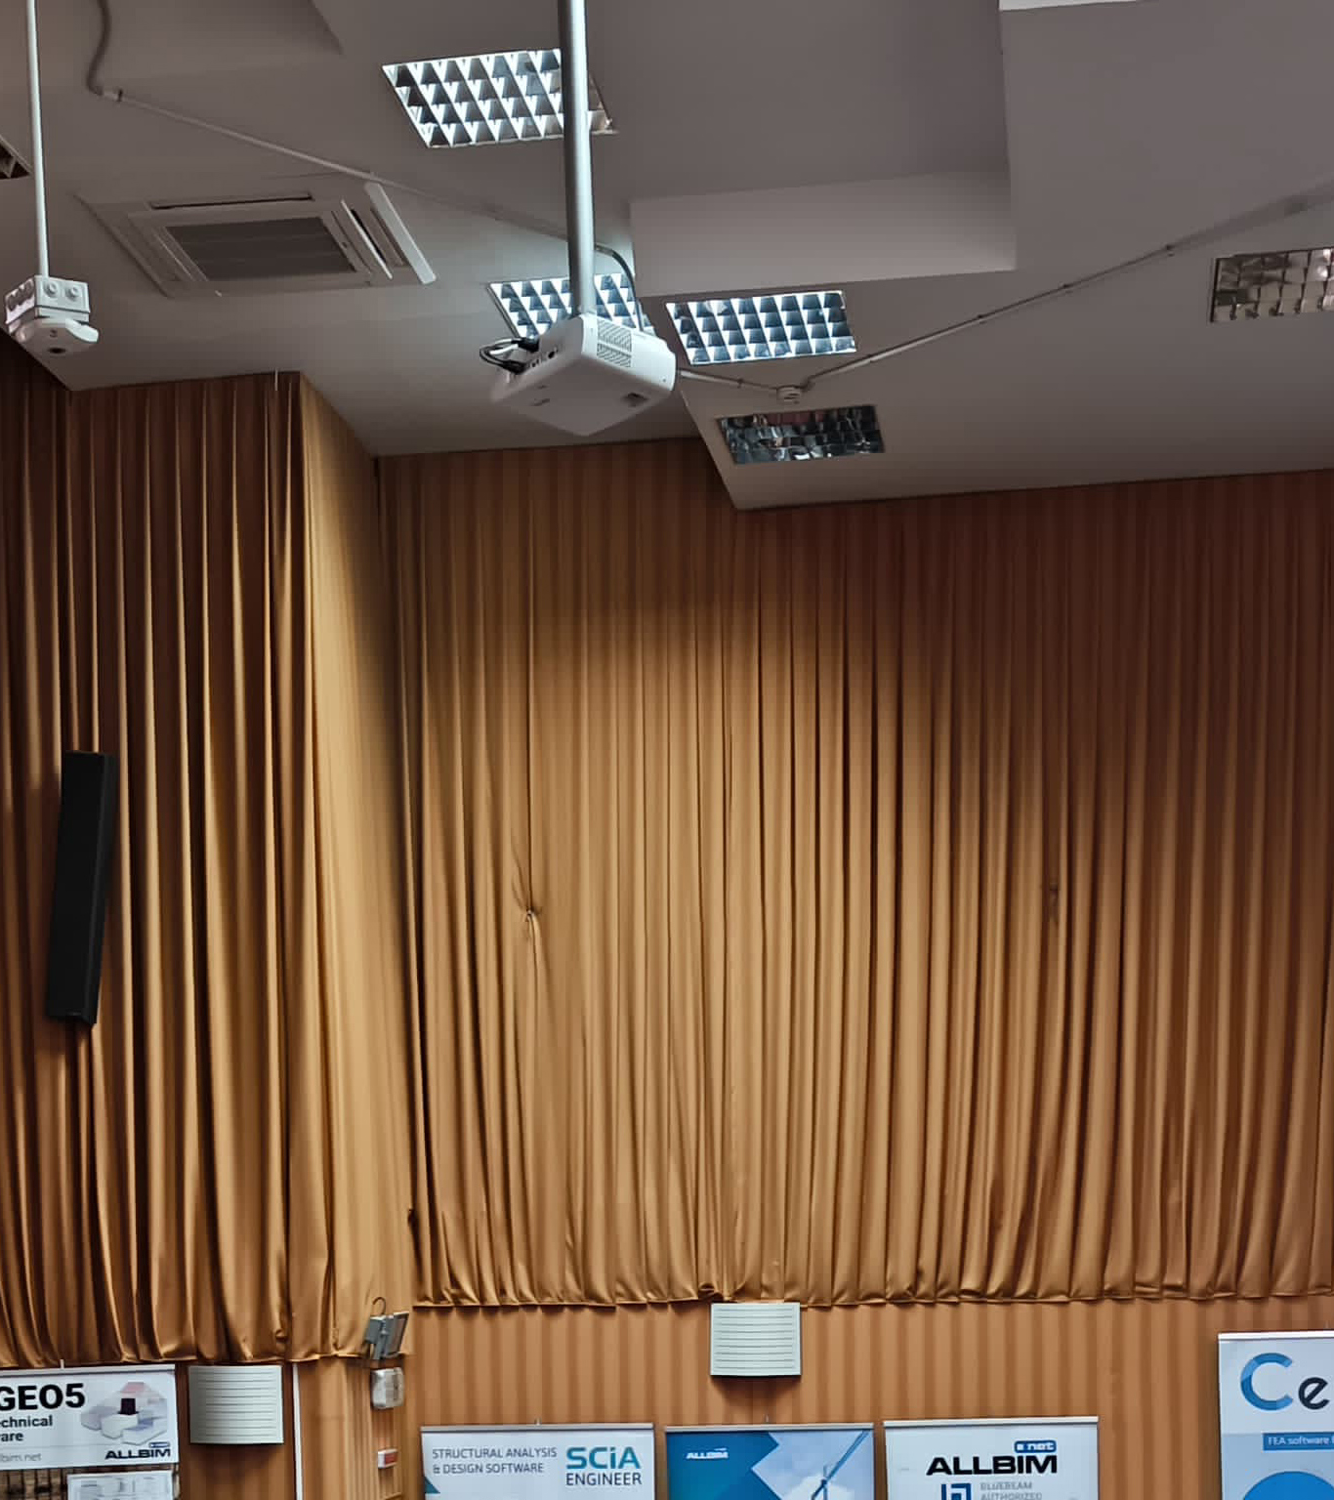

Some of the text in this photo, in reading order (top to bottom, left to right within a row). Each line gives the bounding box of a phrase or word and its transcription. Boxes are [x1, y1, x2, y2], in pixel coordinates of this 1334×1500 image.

[1268, 1434, 1287, 1446] FEA
[1288, 1433, 1329, 1446] software
[105, 1448, 171, 1460] ALLBIM
[432, 1446, 558, 1460] STRUCTURAL ANALYSIS
[442, 1463, 484, 1475] DESIGN
[485, 1462, 544, 1474] SOFTWARE
[925, 1454, 1058, 1476] ALLBIM
[566, 1471, 642, 1487] ENGINEER
[979, 1481, 1033, 1492] BLUEBEAM
